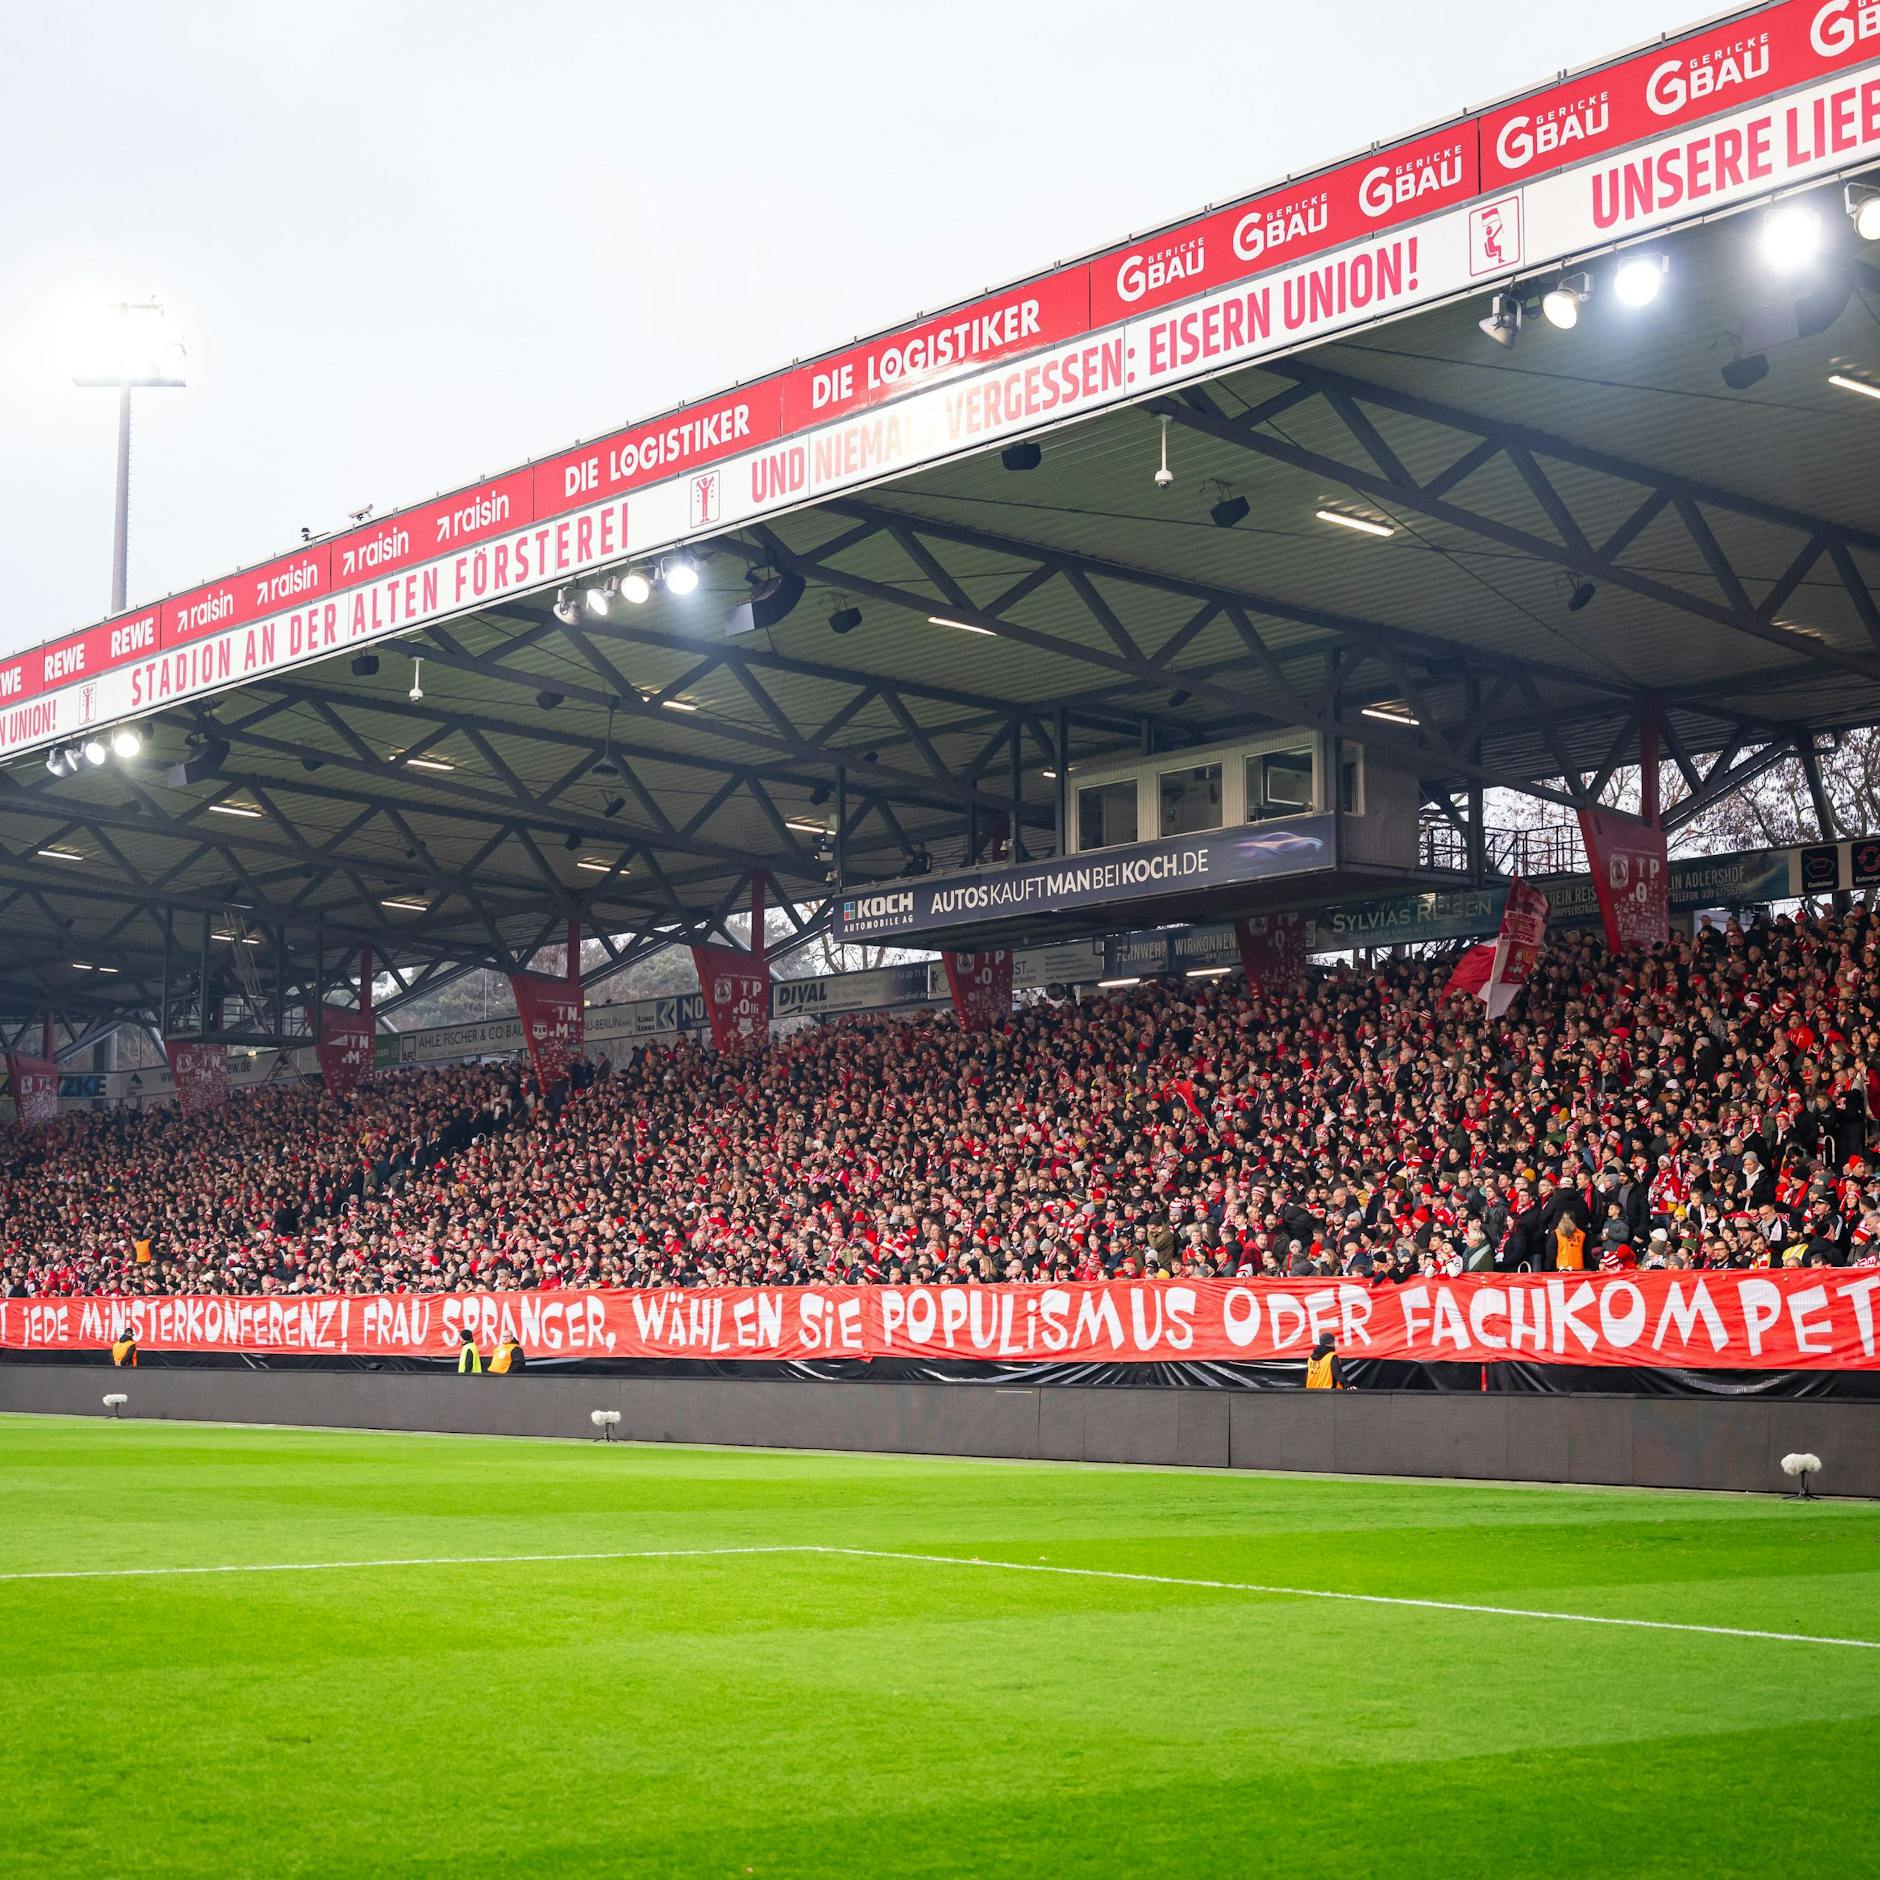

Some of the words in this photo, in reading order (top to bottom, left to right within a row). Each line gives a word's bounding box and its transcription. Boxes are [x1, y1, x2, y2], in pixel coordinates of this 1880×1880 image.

[1688, 32, 1769, 69] GERICKE
[1535, 91, 1609, 125] GERICKE
[1395, 144, 1463, 176] GERICKE
[1591, 115, 1773, 230] UNSERE
[1266, 192, 1328, 222] GERICKE
[1146, 236, 1206, 263] GERICKE
[751, 445, 806, 505] UND
[1149, 286, 1270, 376] EISERN
[1283, 235, 1419, 330] UNION!
[812, 363, 854, 410] DIE
[867, 298, 1041, 391] LOGISTIKER
[565, 456, 599, 498] DIE
[610, 403, 751, 482] LOGISTIKER
[452, 489, 510, 537] raisin
[358, 526, 410, 568] raisin
[270, 561, 319, 601] raisin
[131, 637, 232, 706] STADION
[244, 622, 276, 670] AN
[289, 602, 338, 658] DER
[352, 566, 439, 637] ALTEN
[455, 501, 630, 603] FÖRSTEREI
[190, 588, 235, 629] raisin
[111, 616, 155, 658] REWE
[44, 642, 86, 682] REWE
[0, 665, 22, 698] WE
[9, 699, 57, 745] UNION!
[1685, 865, 1745, 889] ADLERSHOF
[857, 891, 914, 919] KOCH
[1672, 890, 1699, 903] TELEFON
[843, 916, 899, 934] AUTOMOBILE
[902, 914, 914, 925] AG
[1332, 907, 1411, 933] SYLVIAS
[1174, 937, 1194, 956] WIR
[778, 981, 828, 1007] DIVAL
[443, 1028, 478, 1046] FISCHER
[480, 1028, 486, 1041] &
[363, 1297, 430, 1346] FRAU
[631, 1290, 784, 1354] WÄHLEN
[1222, 1283, 1373, 1351] ODER
